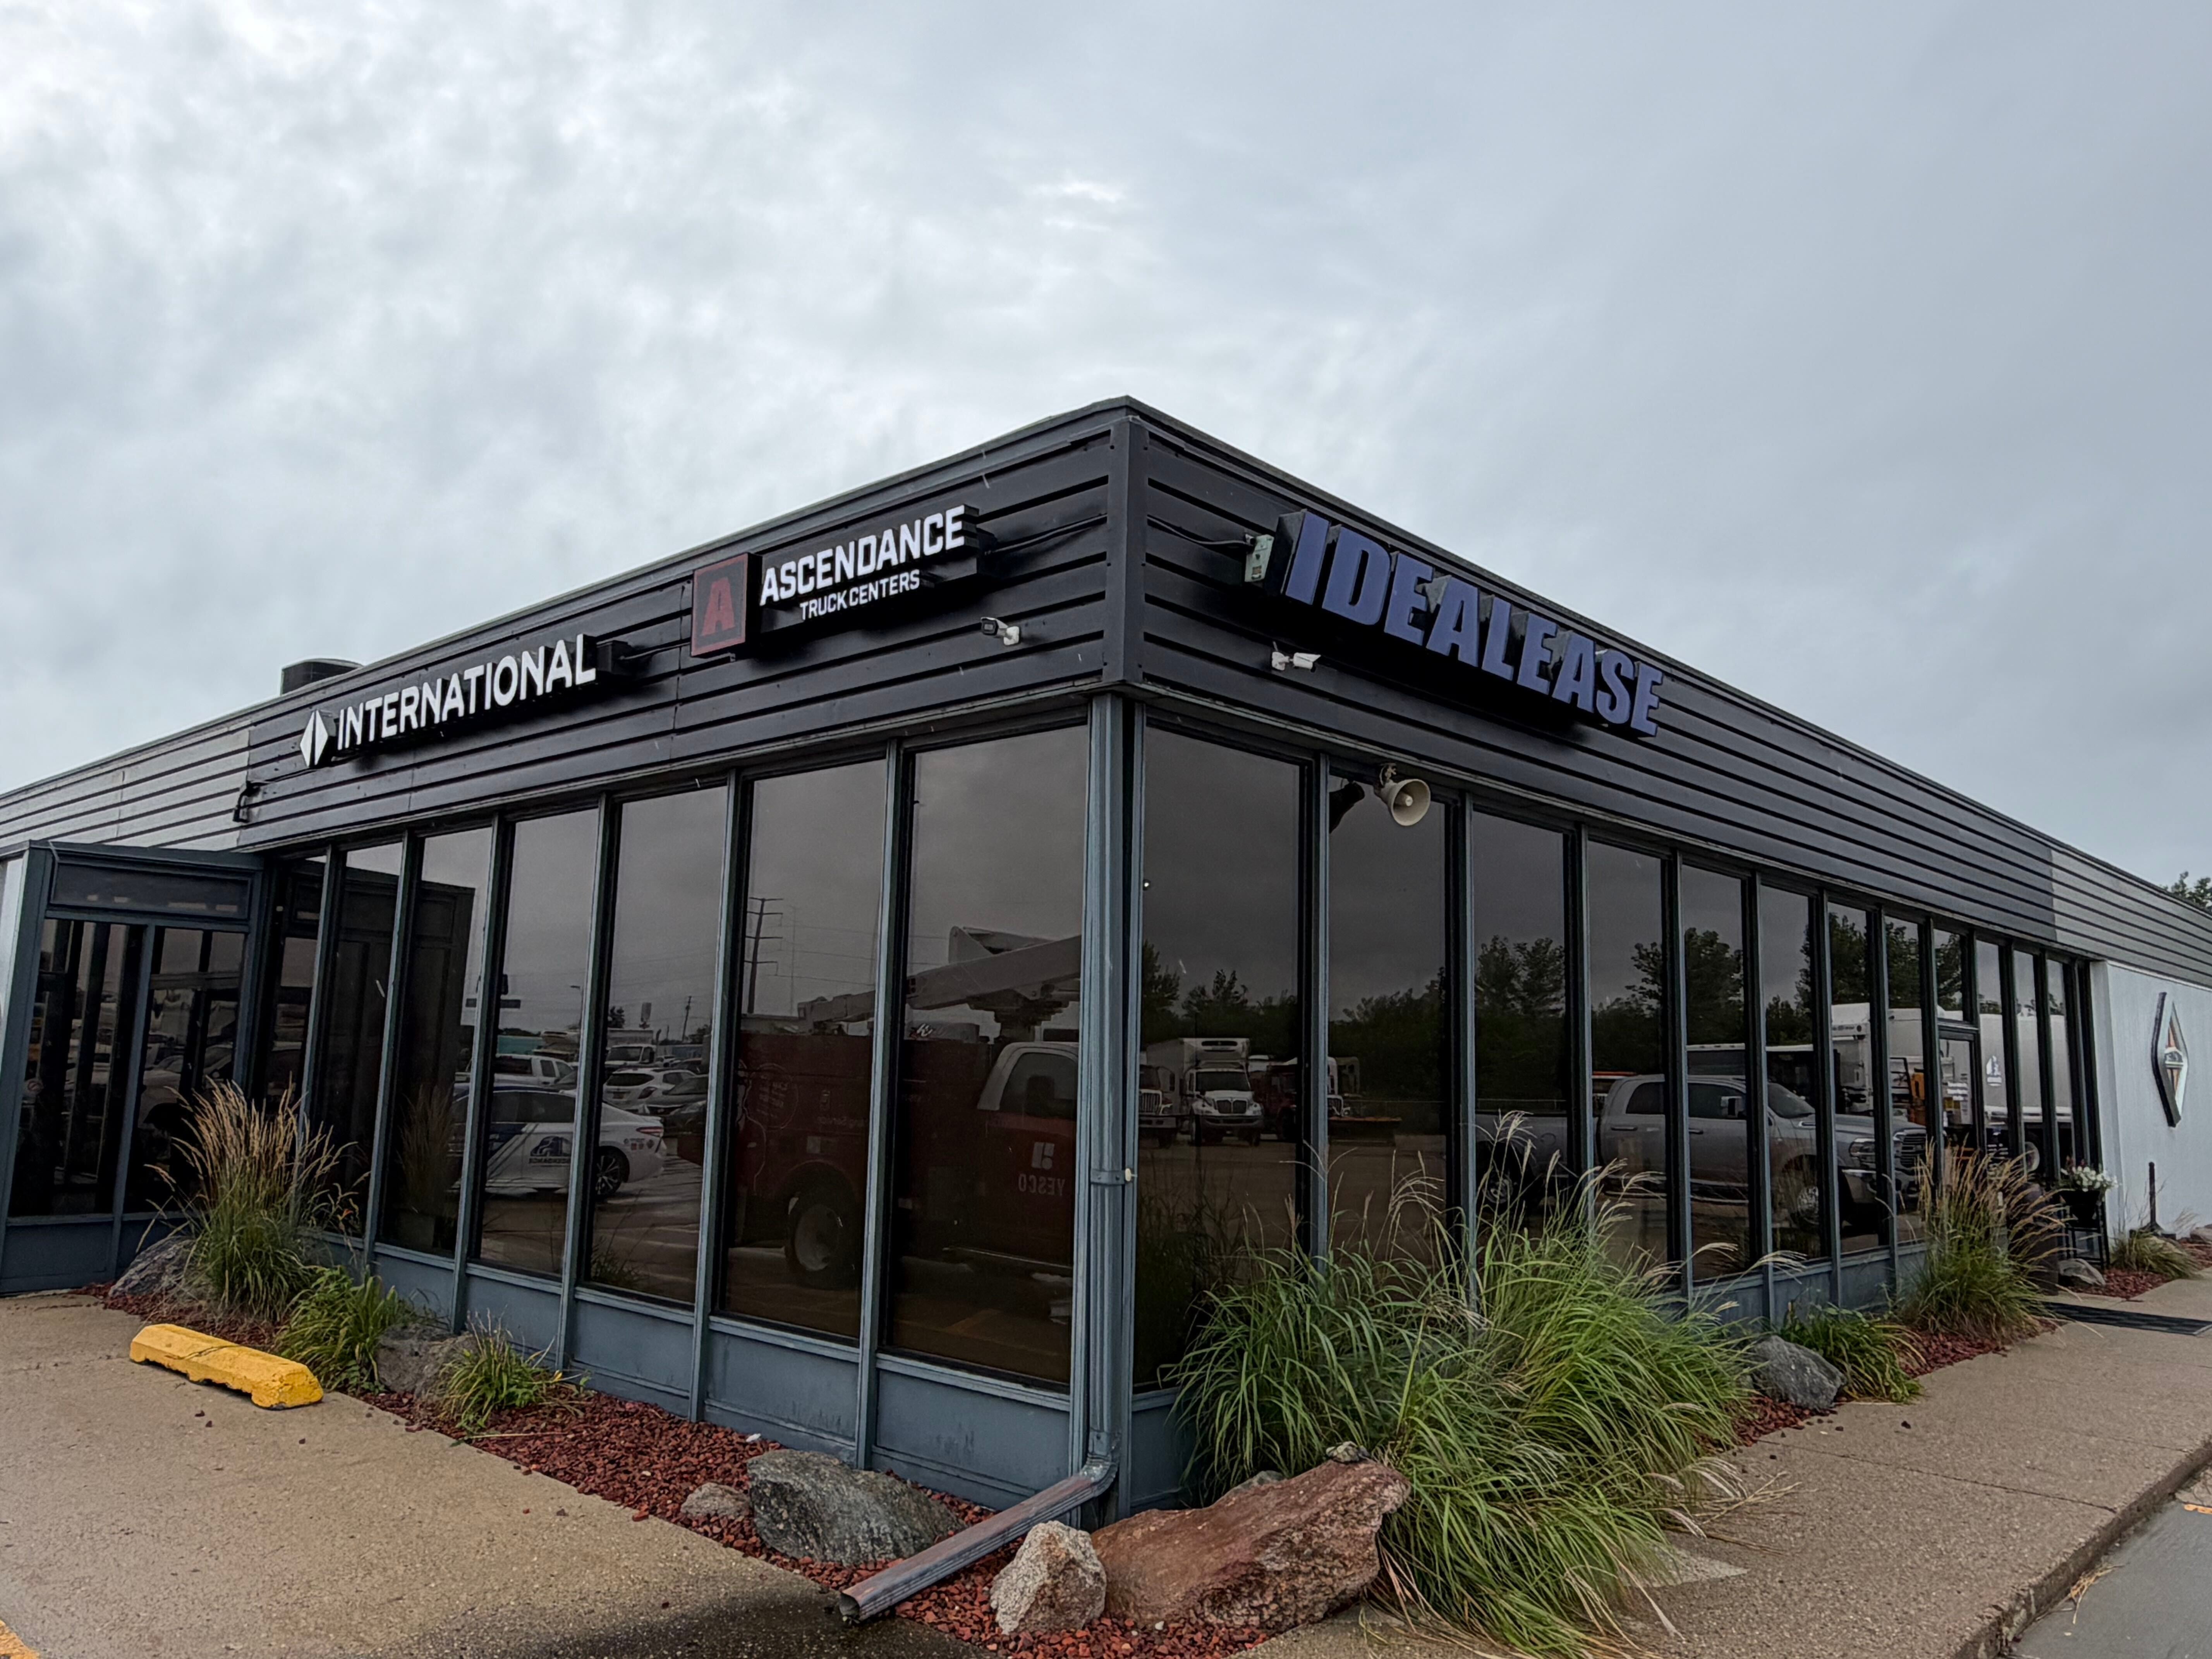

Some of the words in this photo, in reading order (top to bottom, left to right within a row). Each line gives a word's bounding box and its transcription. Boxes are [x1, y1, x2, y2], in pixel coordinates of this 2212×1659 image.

[760, 505, 964, 605] ASCENDANCE
[800, 589, 847, 620] TRUCK
[850, 569, 920, 606] CENTERS
[702, 576, 735, 636] A
[1286, 510, 1663, 737] IDEALEASE
[338, 634, 596, 750] INTERNATIONAL
